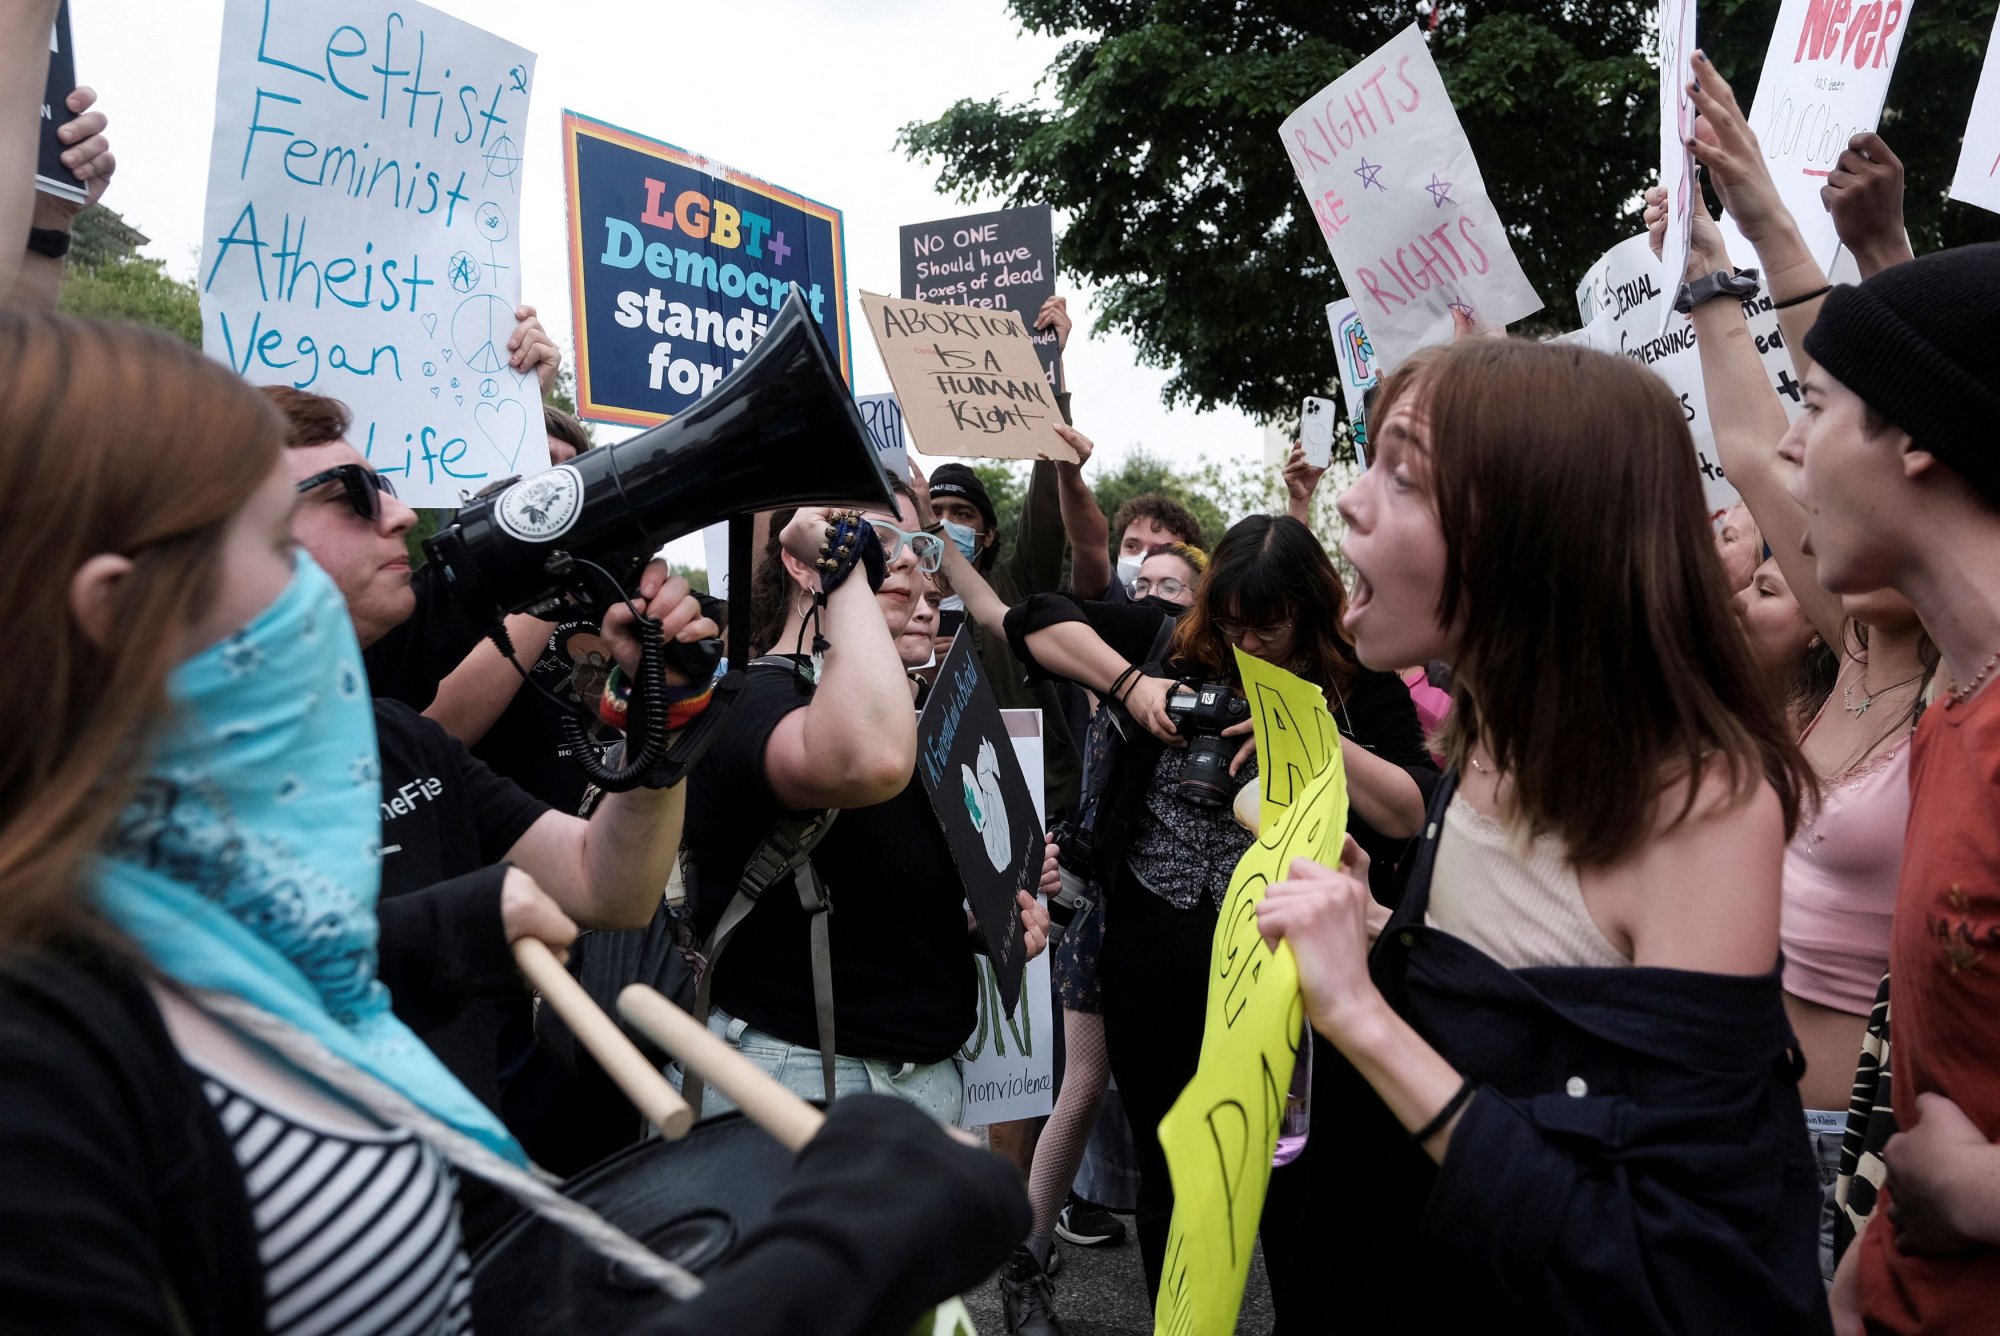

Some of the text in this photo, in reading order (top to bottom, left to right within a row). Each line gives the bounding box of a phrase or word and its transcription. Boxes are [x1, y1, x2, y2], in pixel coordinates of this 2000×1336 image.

[259, 0, 507, 148] Leftist
[1295, 55, 1421, 173] RIGHTS
[241, 87, 470, 227] Feminist
[640, 177, 791, 266] LGBT+
[914, 223, 999, 258] NO ONE
[205, 200, 434, 312] Atheist
[600, 216, 825, 324] Democrt
[915, 260, 1044, 301] boxes of dead
[980, 246, 1032, 268] have
[1356, 215, 1489, 316] RIGHTS
[220, 311, 402, 389] Vegan
[883, 305, 1032, 340] ABORTION
[648, 342, 723, 398] for
[933, 343, 1003, 373] IS A
[936, 375, 1050, 409] HUMAN
[365, 422, 488, 485] Life
[967, 1073, 1053, 1105] nonviolence
